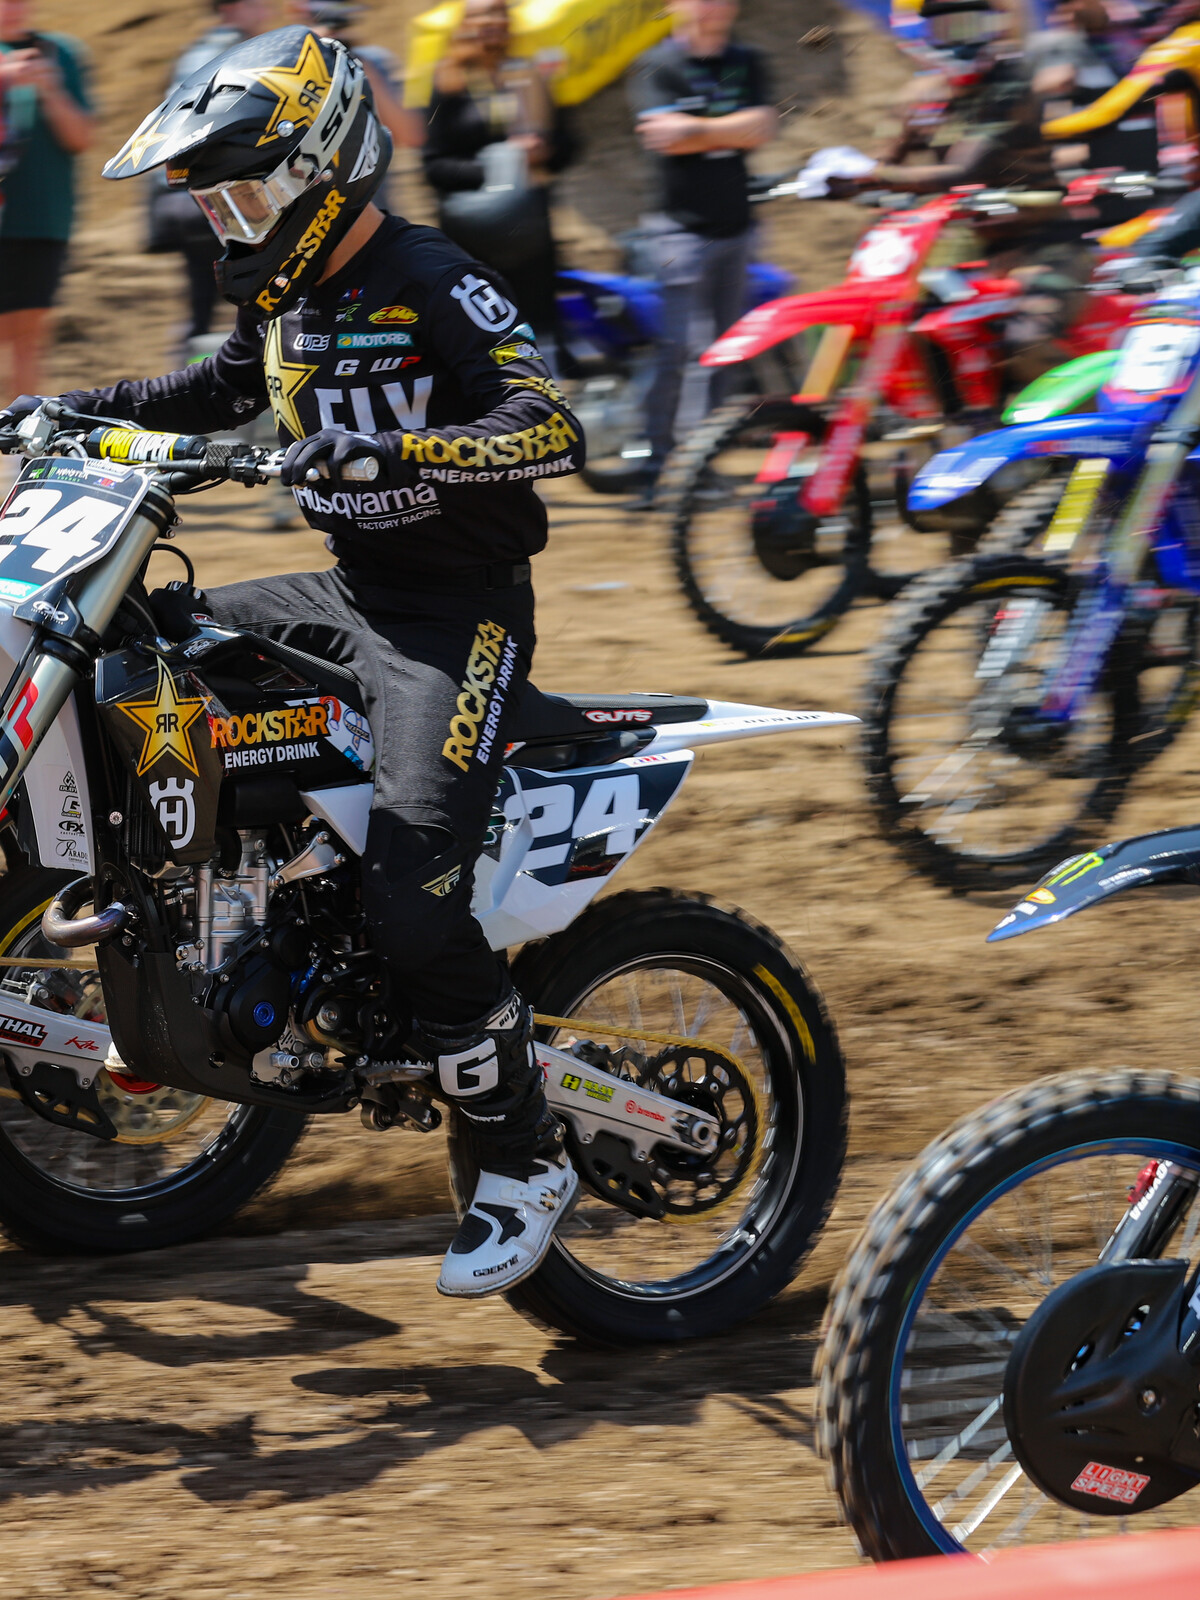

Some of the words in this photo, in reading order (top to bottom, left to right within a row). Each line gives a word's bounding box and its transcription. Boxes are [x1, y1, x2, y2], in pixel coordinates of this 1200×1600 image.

[352, 332, 413, 347] MOTOREX
[401, 412, 579, 468] ROCKSTAR
[419, 467, 504, 484] ENERGY
[507, 455, 576, 482] DRINK
[357, 519, 400, 531] FACTORY
[402, 508, 442, 525] RACING
[476, 689, 506, 765] ENERGY
[496, 635, 519, 693] DRINK
[210, 705, 330, 749] ROCKSTAR
[584, 708, 653, 723] GUTS
[224, 748, 275, 769] ENERGY
[276, 742, 321, 763] DRINK
[503, 774, 650, 872] 24
[636, 1107, 667, 1122] brembo
[1084, 1462, 1150, 1489] LIGHT
[1071, 1476, 1140, 1504] SPEED
